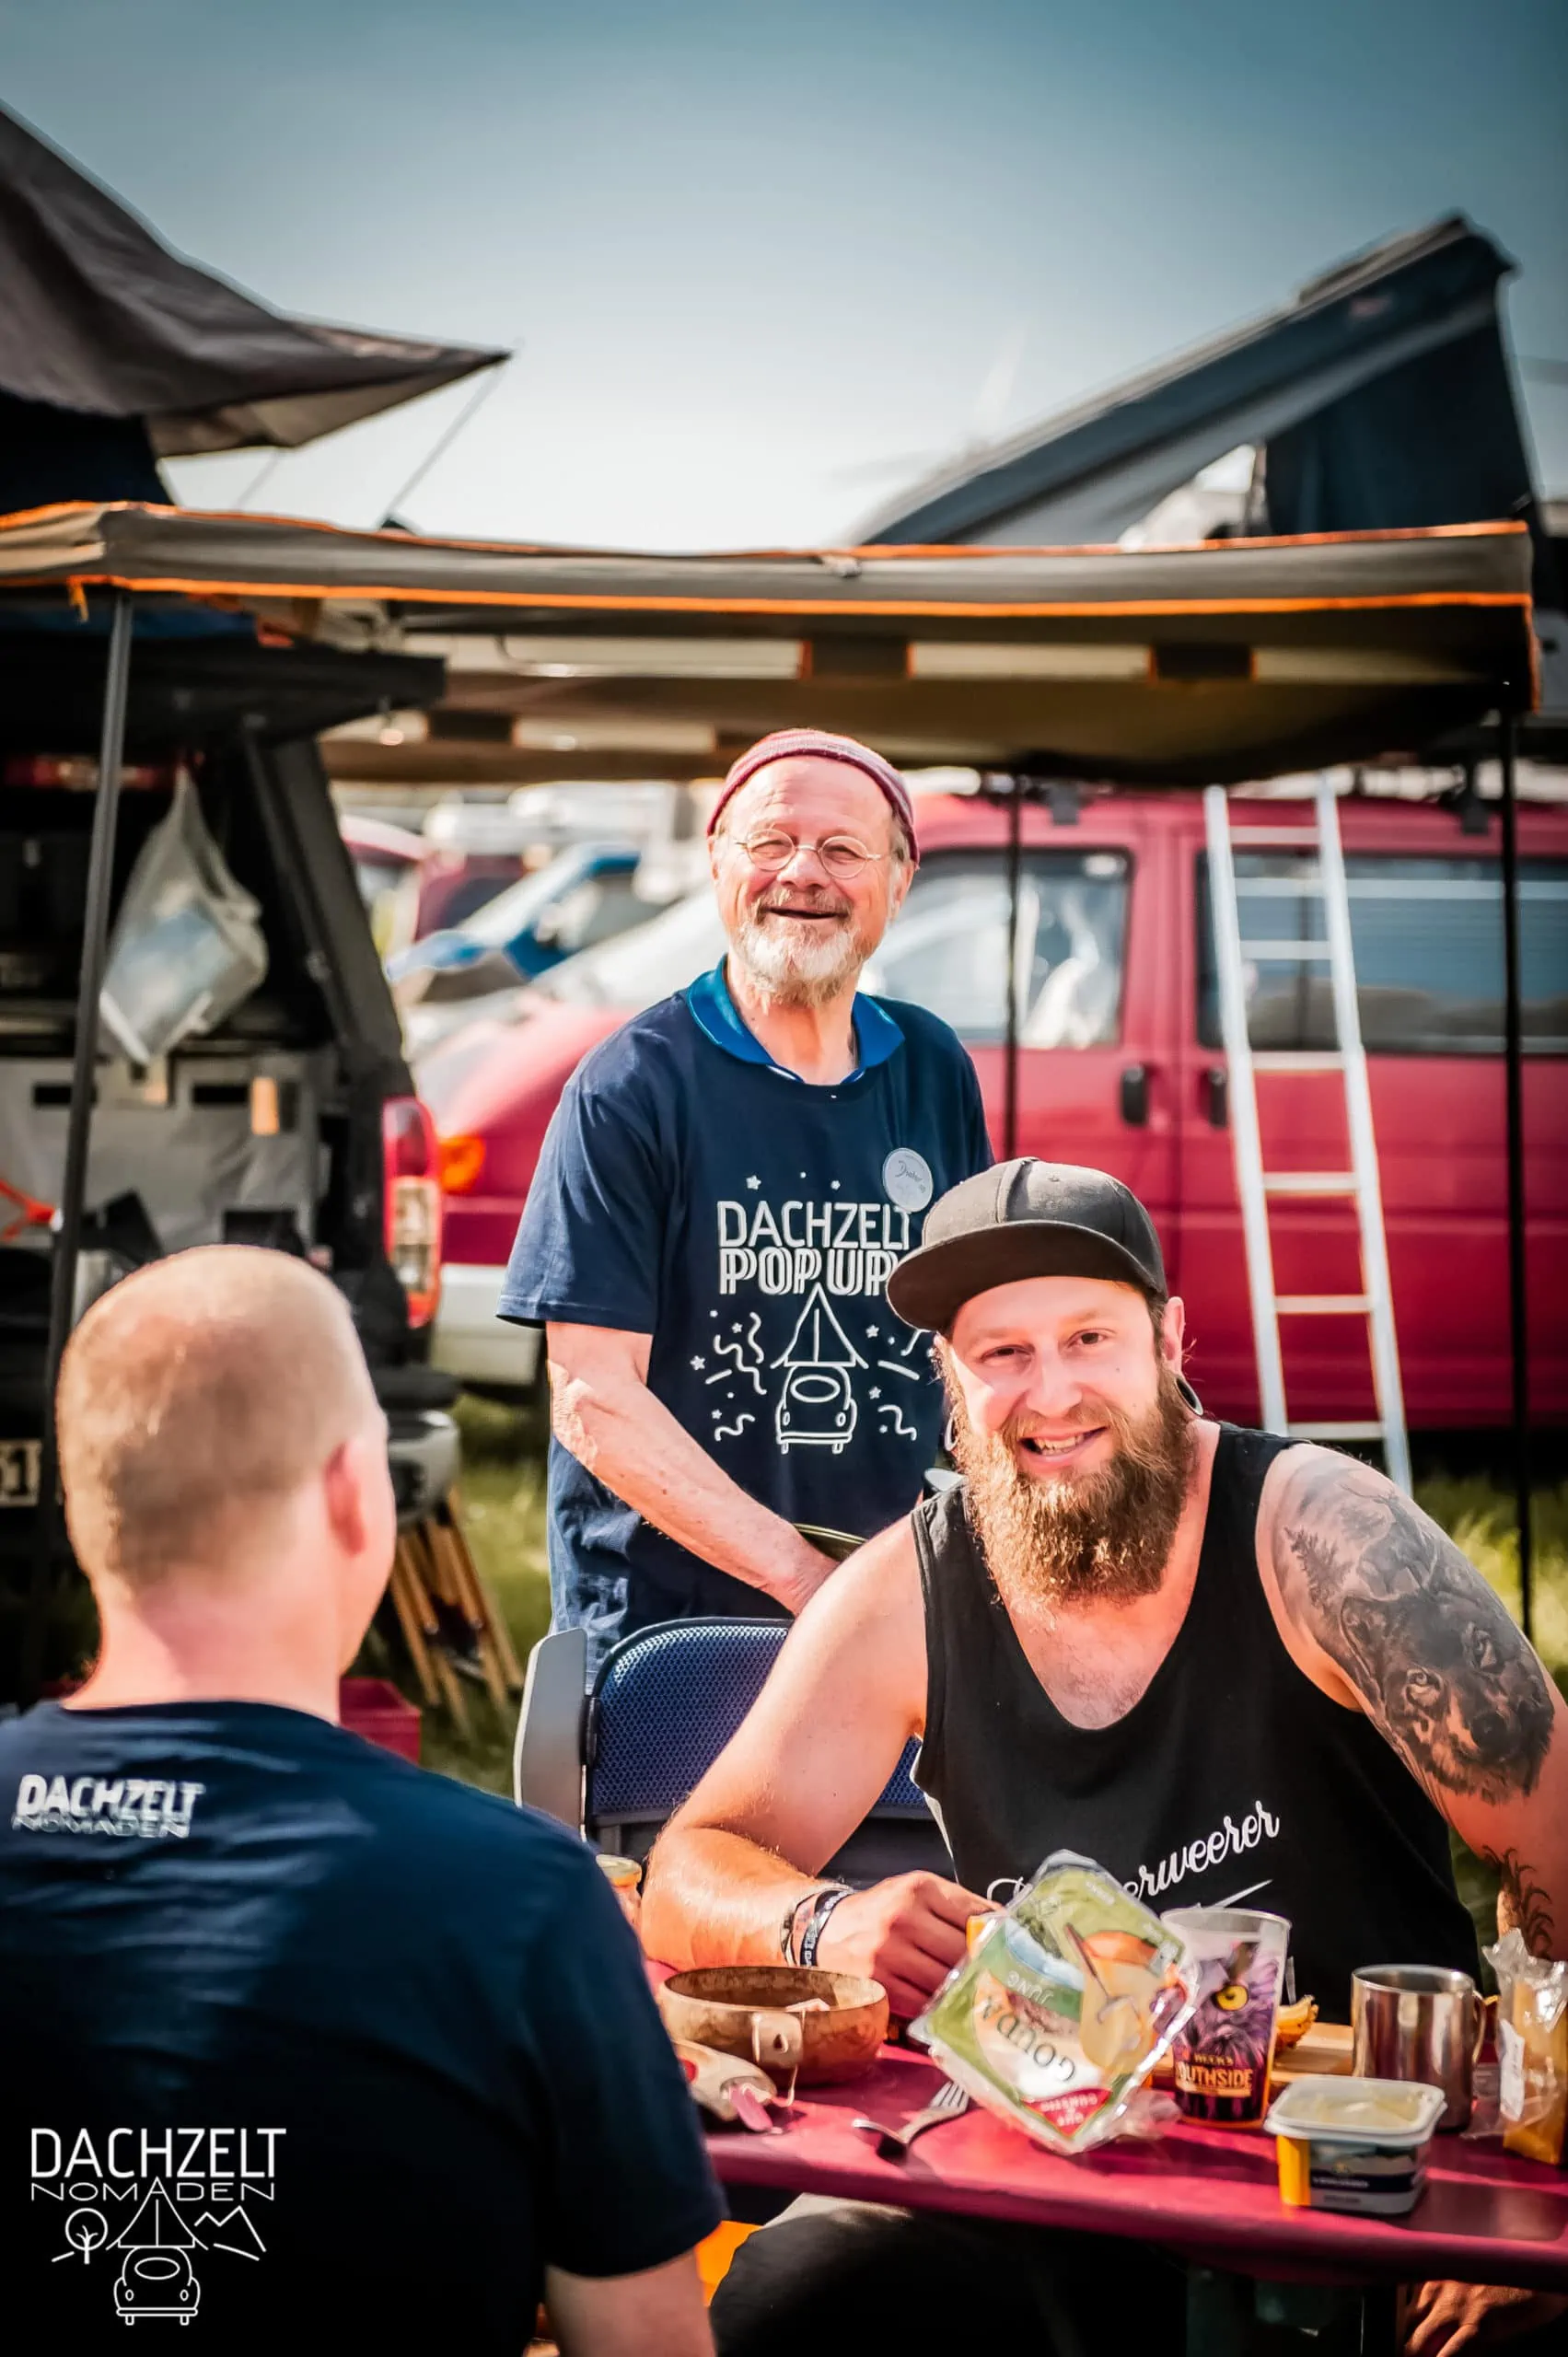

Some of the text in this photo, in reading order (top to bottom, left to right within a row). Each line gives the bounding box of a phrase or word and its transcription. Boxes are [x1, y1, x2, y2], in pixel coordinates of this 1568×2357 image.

[716, 1201, 912, 1250] DACHZELT
[719, 1247, 900, 1296] POP UP
[16, 1774, 206, 1819] DACHZELT
[1006, 1969, 1054, 2005] JUNG
[981, 1993, 1075, 2083] GOUDA
[1175, 2061, 1253, 2089] OUTHSIDE
